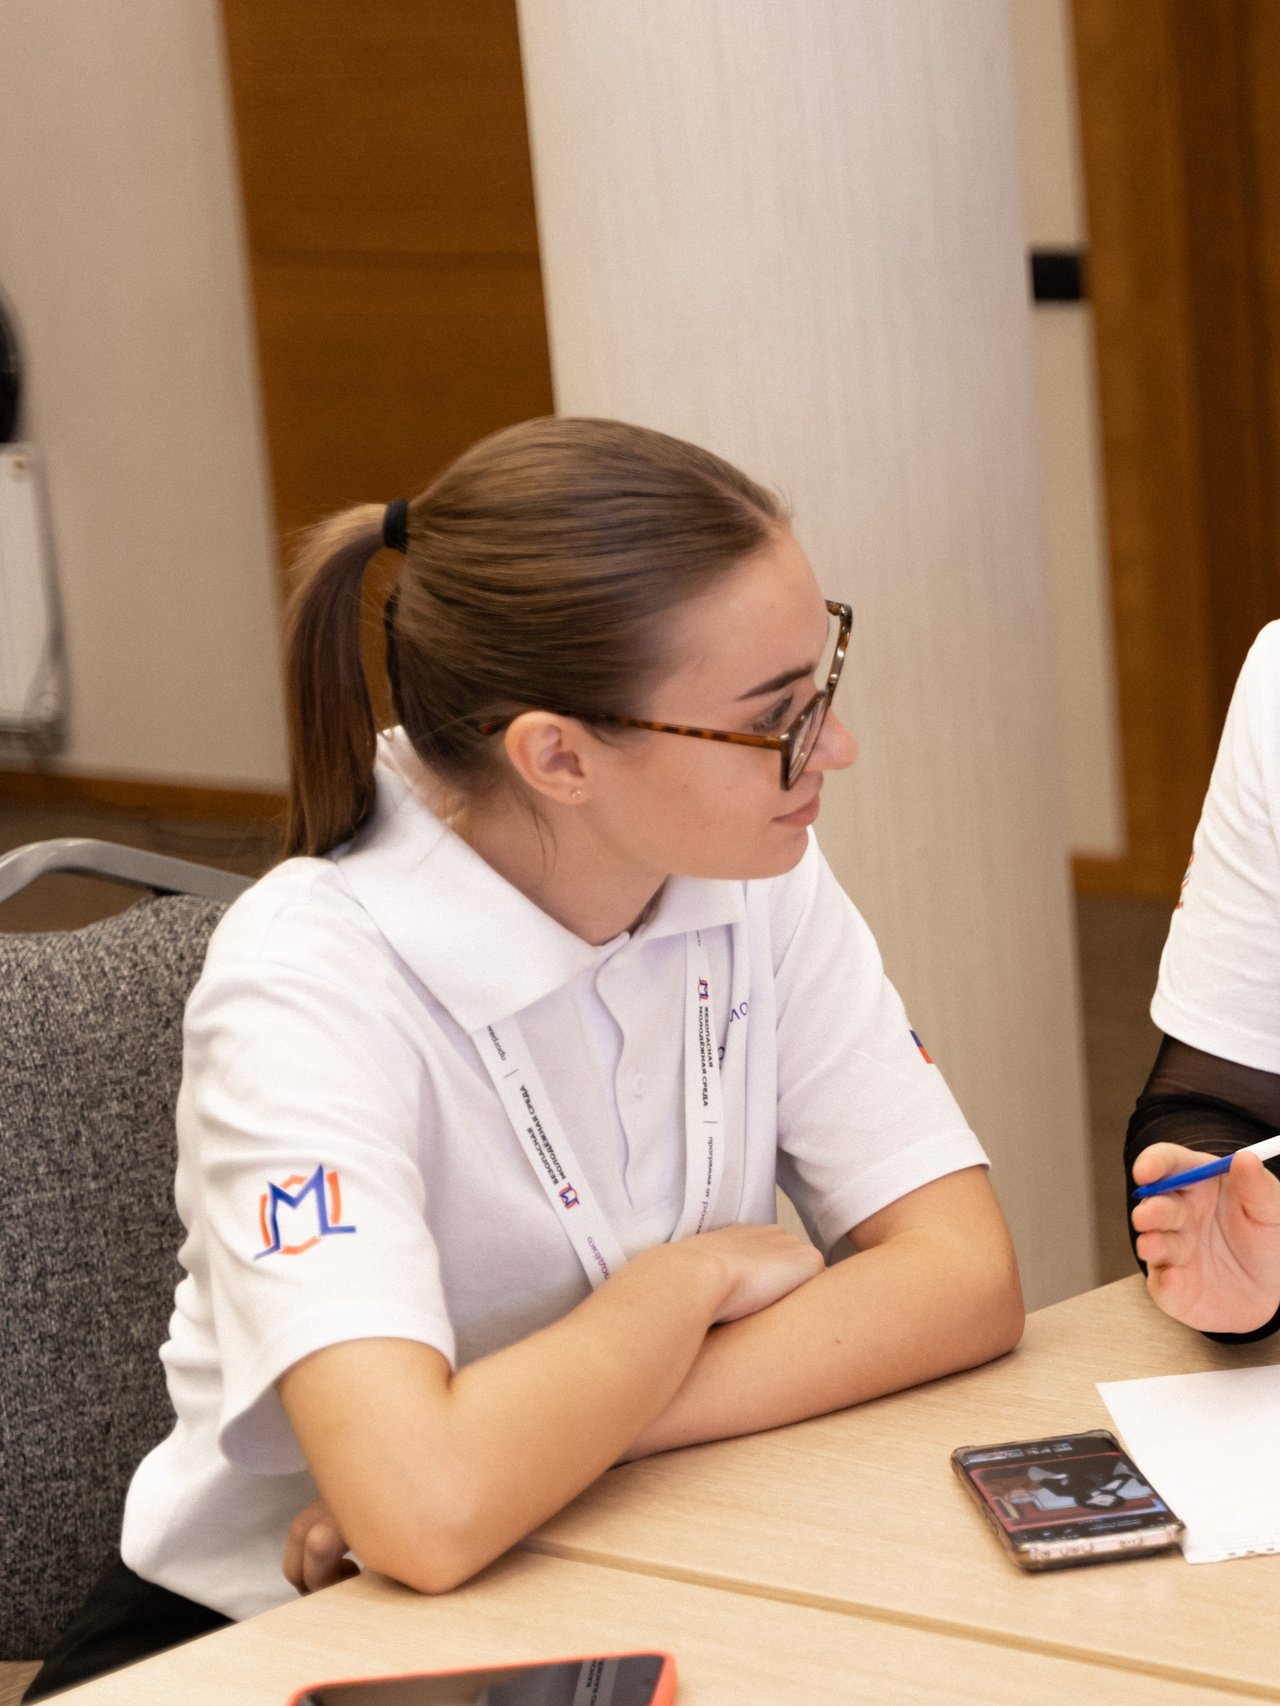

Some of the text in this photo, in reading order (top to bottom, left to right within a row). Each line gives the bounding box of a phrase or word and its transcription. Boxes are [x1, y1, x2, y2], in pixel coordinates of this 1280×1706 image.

[704, 1006, 714, 1068] БЕЗОПАСНАЯ
[520, 1084, 566, 1180] МОЛОДЁЖНАЯ СРЕДА
[527, 1126, 559, 1185] БЕЗОПАСНАЯ
